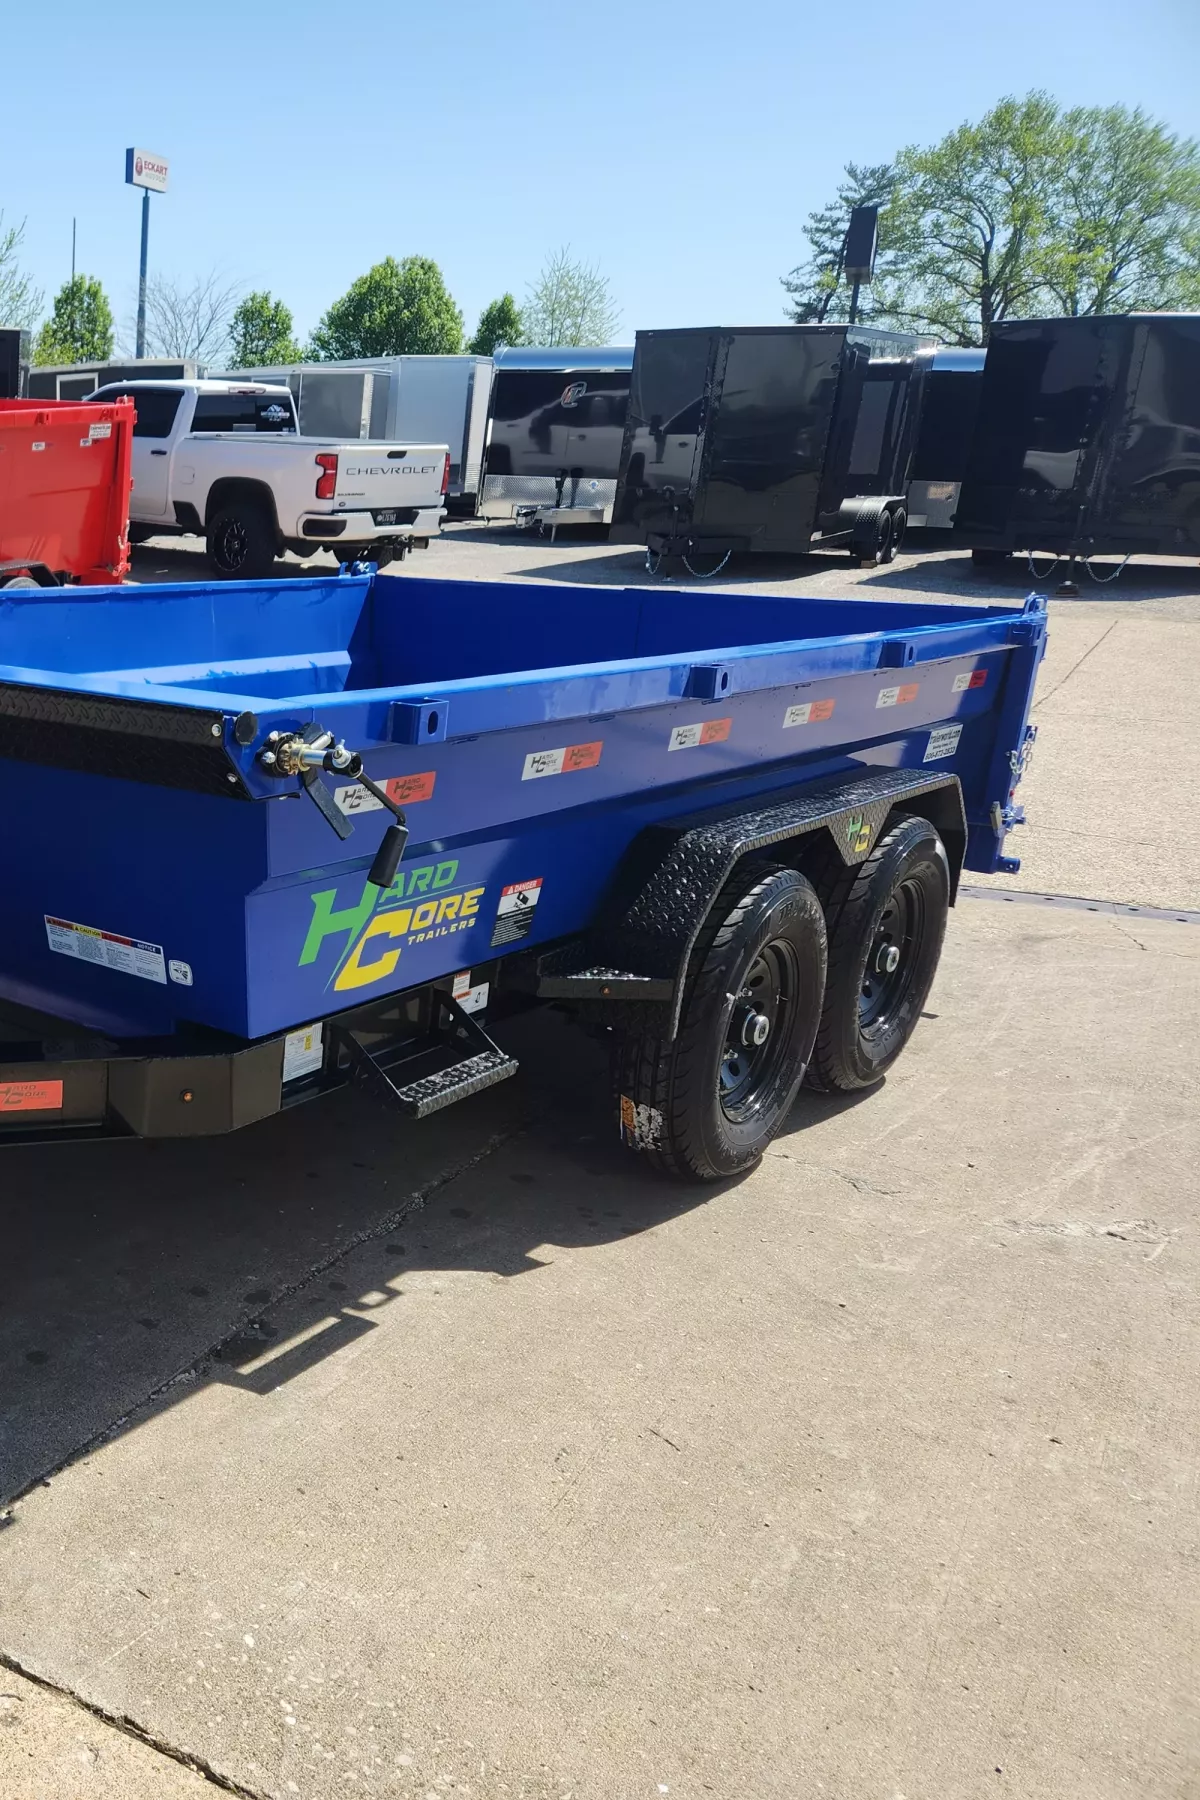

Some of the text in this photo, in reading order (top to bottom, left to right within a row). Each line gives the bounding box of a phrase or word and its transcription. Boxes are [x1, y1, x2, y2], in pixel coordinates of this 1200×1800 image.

[143, 160, 168, 176] ECKART
[346, 466, 438, 475] CHEVROLET
[514, 880, 538, 892] DANGER
[298, 859, 459, 967] HARD
[79, 927, 101, 937] CAUTION
[408, 917, 477, 946] TRAILERS
[334, 887, 485, 991] CORE
[137, 943, 156, 953] NOTICE
